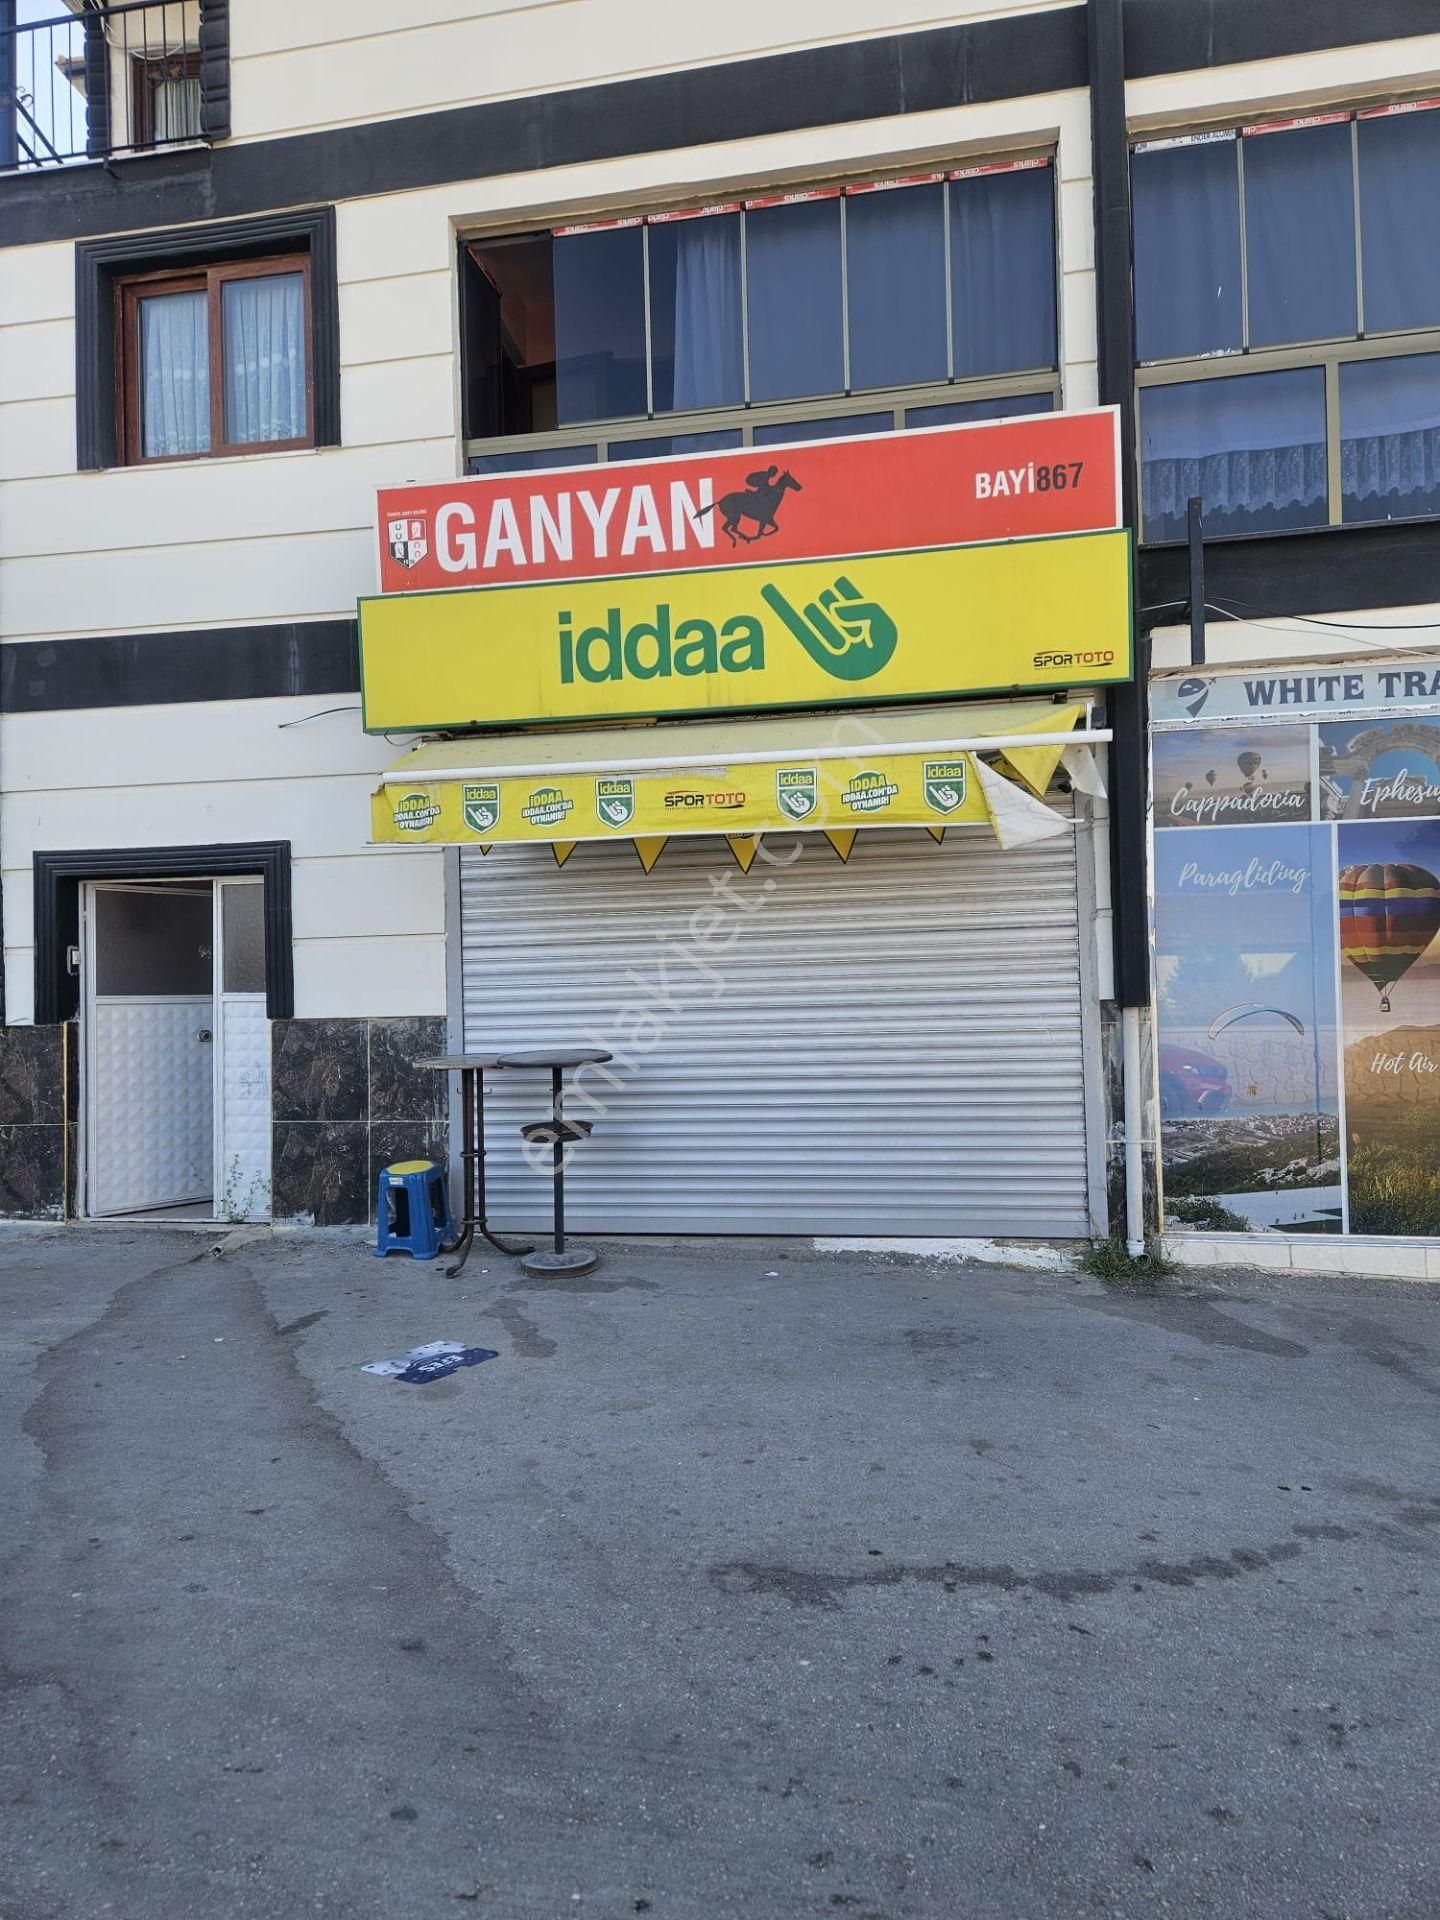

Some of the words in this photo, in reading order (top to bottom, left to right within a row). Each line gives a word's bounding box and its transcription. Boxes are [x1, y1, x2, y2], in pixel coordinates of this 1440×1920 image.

[434, 476, 716, 573] GANYAN
[557, 603, 766, 685] iddaa
[1243, 673, 1365, 707] WHITE
[599, 782, 631, 795] iddaa
[779, 772, 813, 786] iddaa
[927, 765, 962, 778] iddaa
[465, 788, 497, 801] iddaa
[1170, 786, 1306, 822] Cappadocia
[1360, 767, 1440, 813] Ephesu
[1178, 856, 1312, 896] Paragliding
[1370, 1051, 1405, 1074] Hot
[1408, 1051, 1439, 1073] Air
